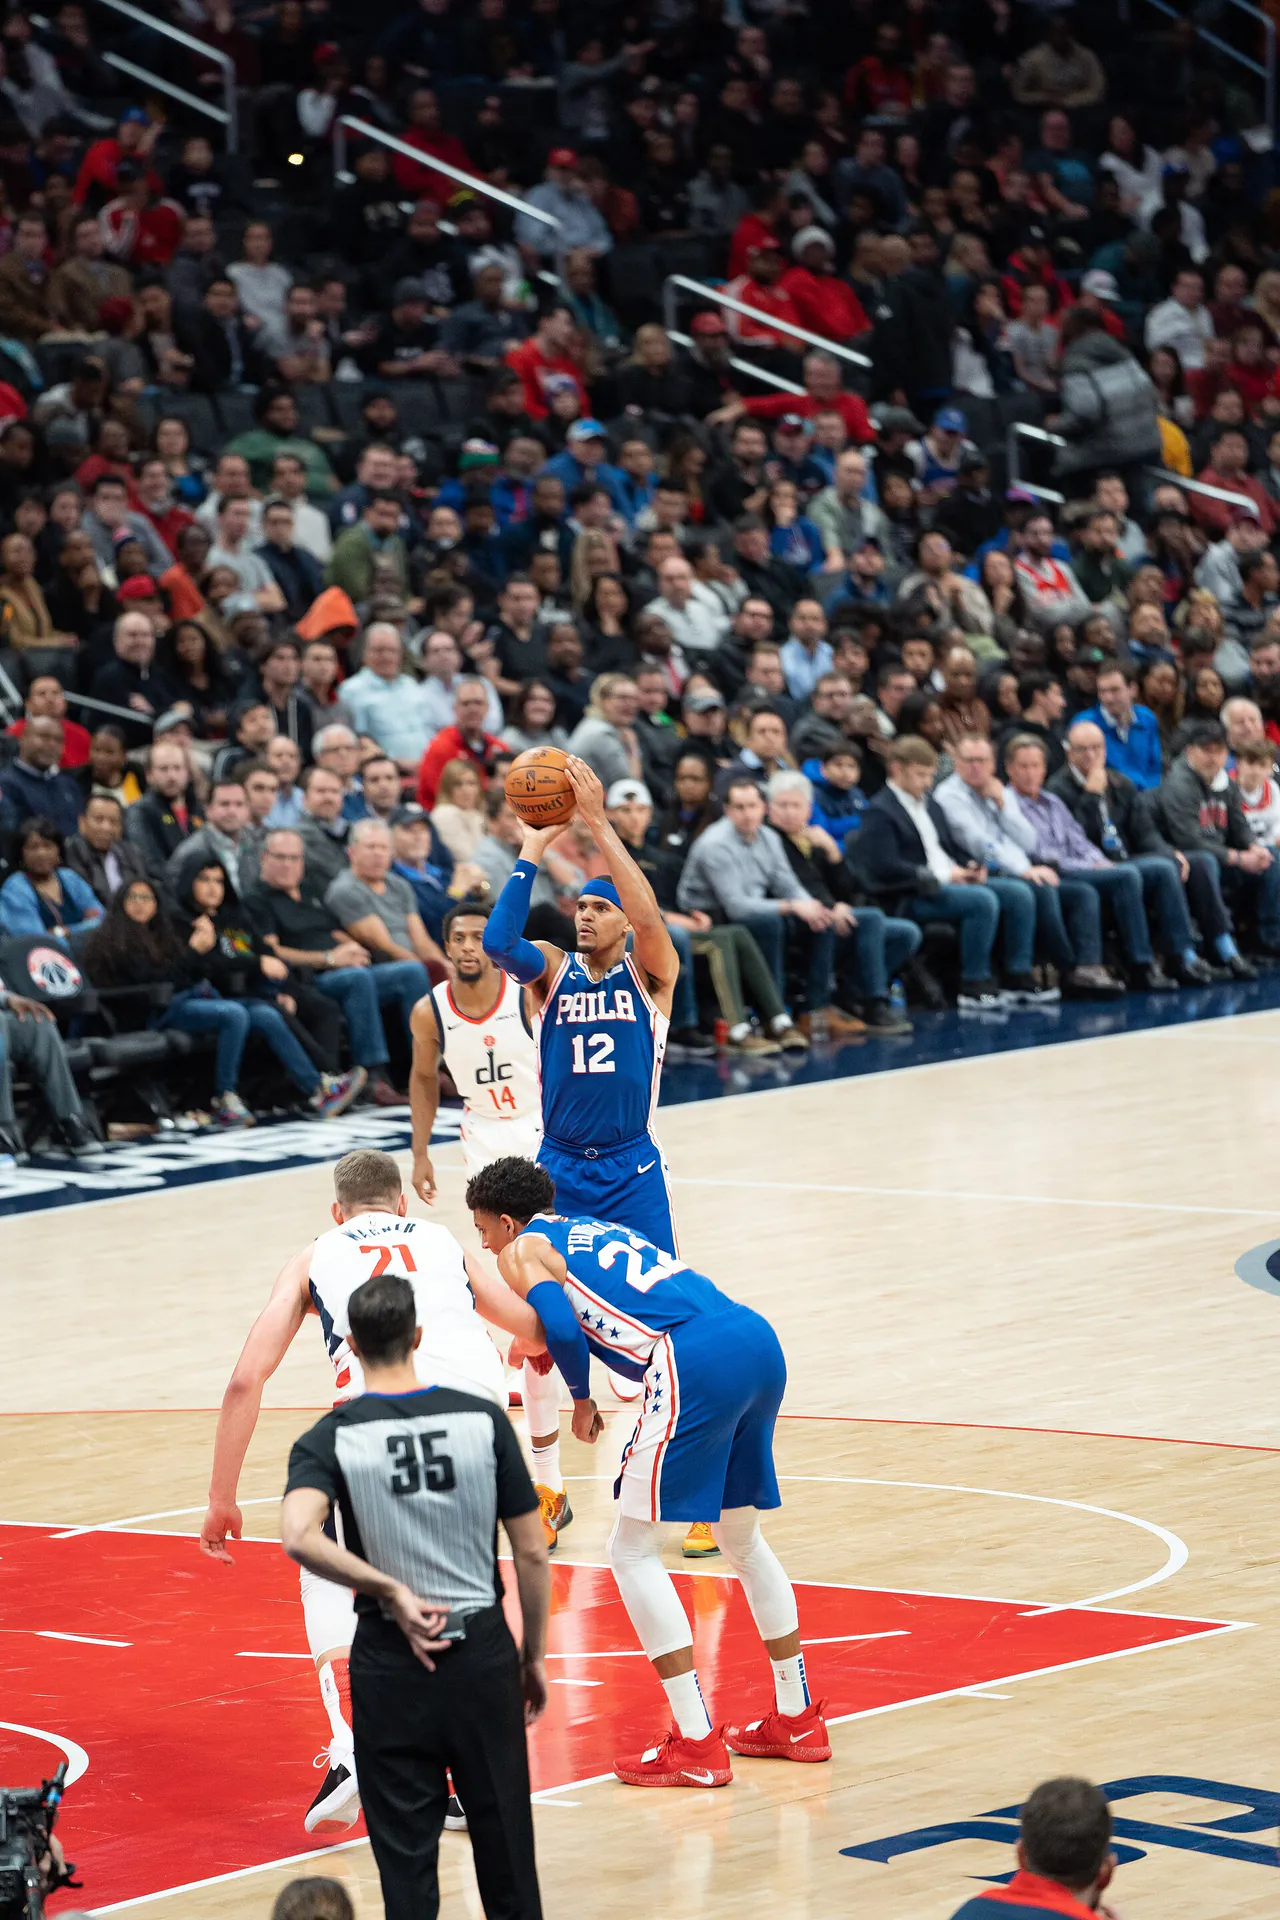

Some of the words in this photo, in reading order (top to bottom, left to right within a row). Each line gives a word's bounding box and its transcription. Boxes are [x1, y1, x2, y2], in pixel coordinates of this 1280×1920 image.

[555, 990, 637, 1025] PHILA
[475, 1048, 513, 1084] dc
[572, 1033, 616, 1074] 12
[487, 1085, 517, 1110] 14
[359, 1244, 417, 1280] 21
[386, 1430, 456, 1493] 35
